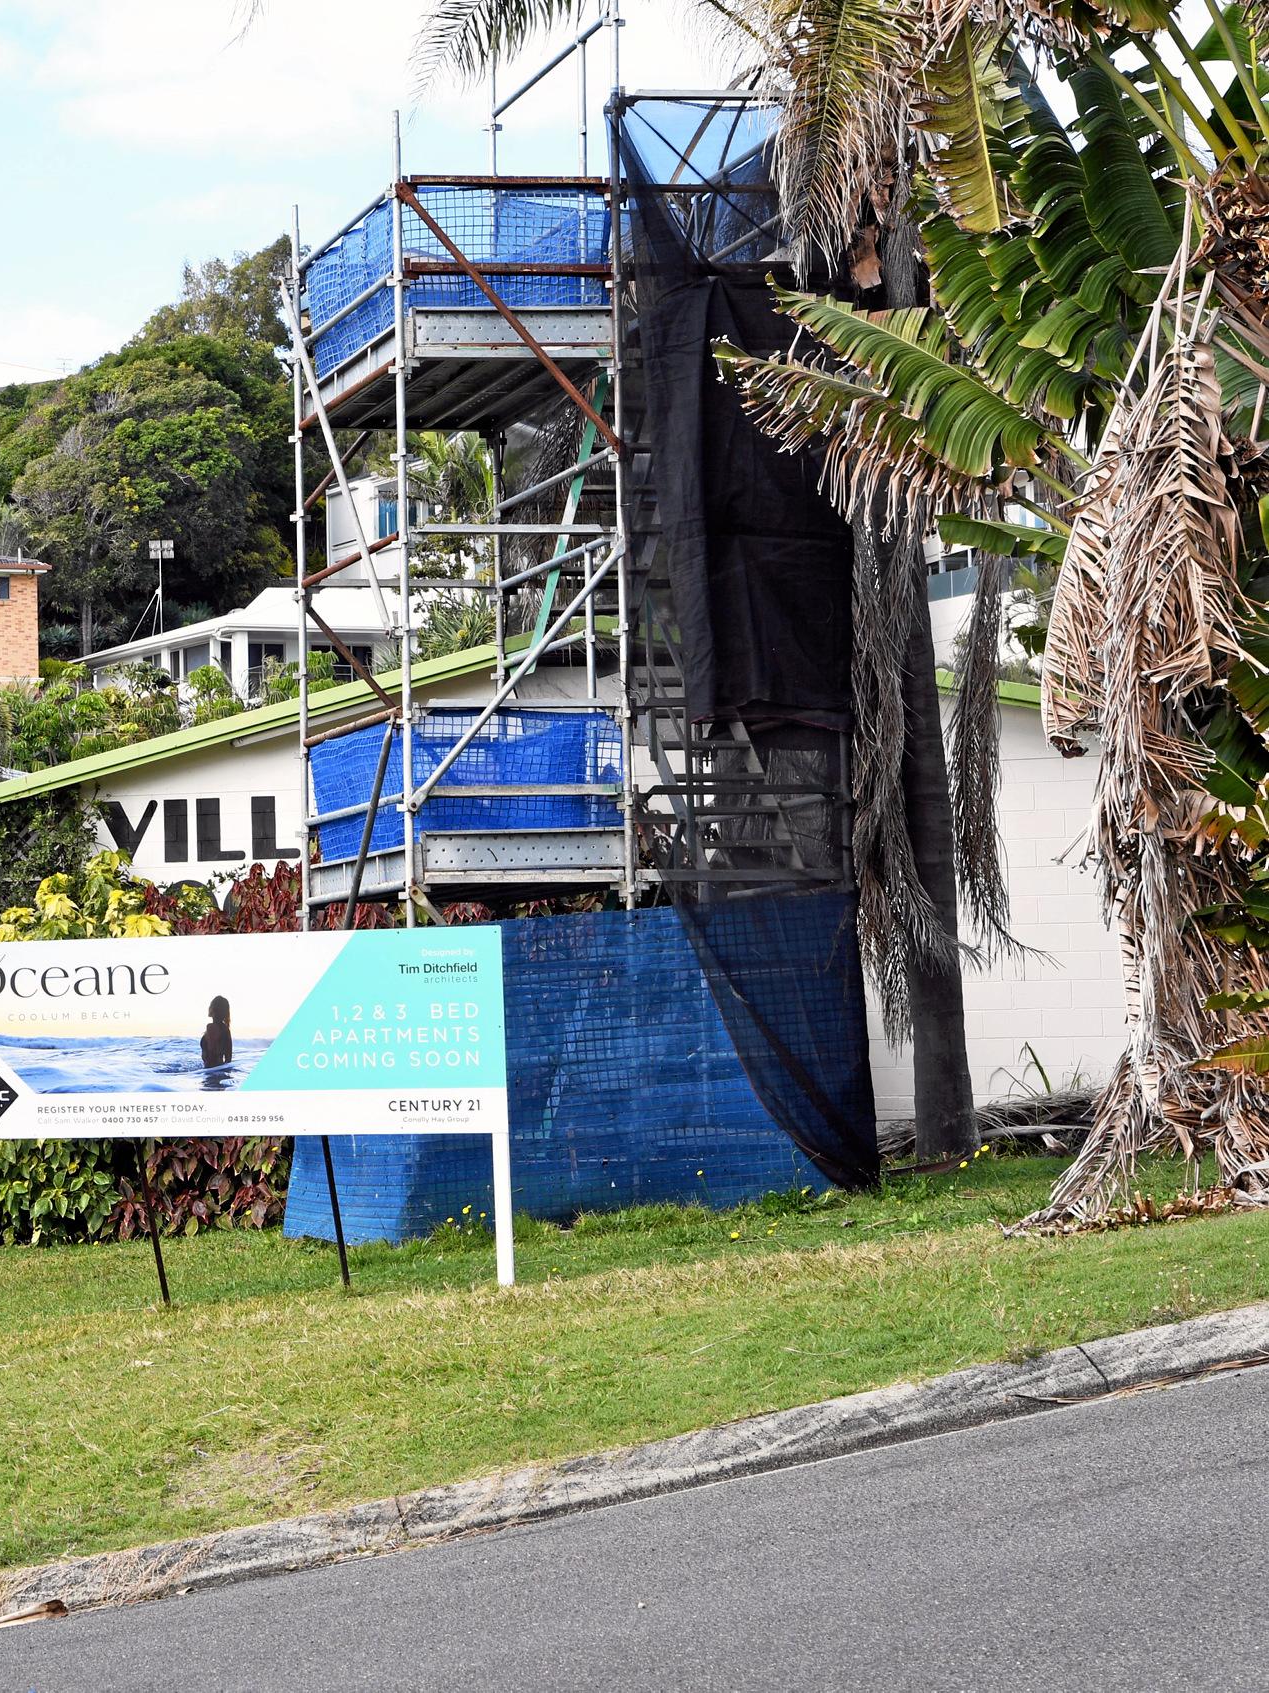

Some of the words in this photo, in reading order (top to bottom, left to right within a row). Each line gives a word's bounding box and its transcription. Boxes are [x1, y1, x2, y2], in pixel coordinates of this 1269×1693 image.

[398, 964, 420, 974] Tim
[423, 962, 478, 973] Ditchfield
[424, 975, 478, 983] architects
[7, 1012, 70, 1022] COOLUM
[81, 1011, 132, 1020] BEACH
[372, 1004, 386, 1020] &
[395, 1003, 407, 1020] 3
[431, 1002, 479, 1019] BED
[312, 1026, 480, 1045] APARTMENTS
[296, 1051, 396, 1069] COMING
[410, 1050, 480, 1067] SOON
[37, 1106, 85, 1114] REGISTER
[88, 1105, 116, 1113] YOUR
[119, 1104, 167, 1113] INTEREST
[171, 1104, 207, 1112] TODAY.
[388, 1099, 462, 1112] CENTURY
[467, 1099, 480, 1111] 21
[37, 1117, 53, 1125] Call
[54, 1116, 71, 1125] Sam
[73, 1116, 99, 1124] Walker
[171, 1115, 194, 1123] David
[447, 1115, 470, 1123] Group
